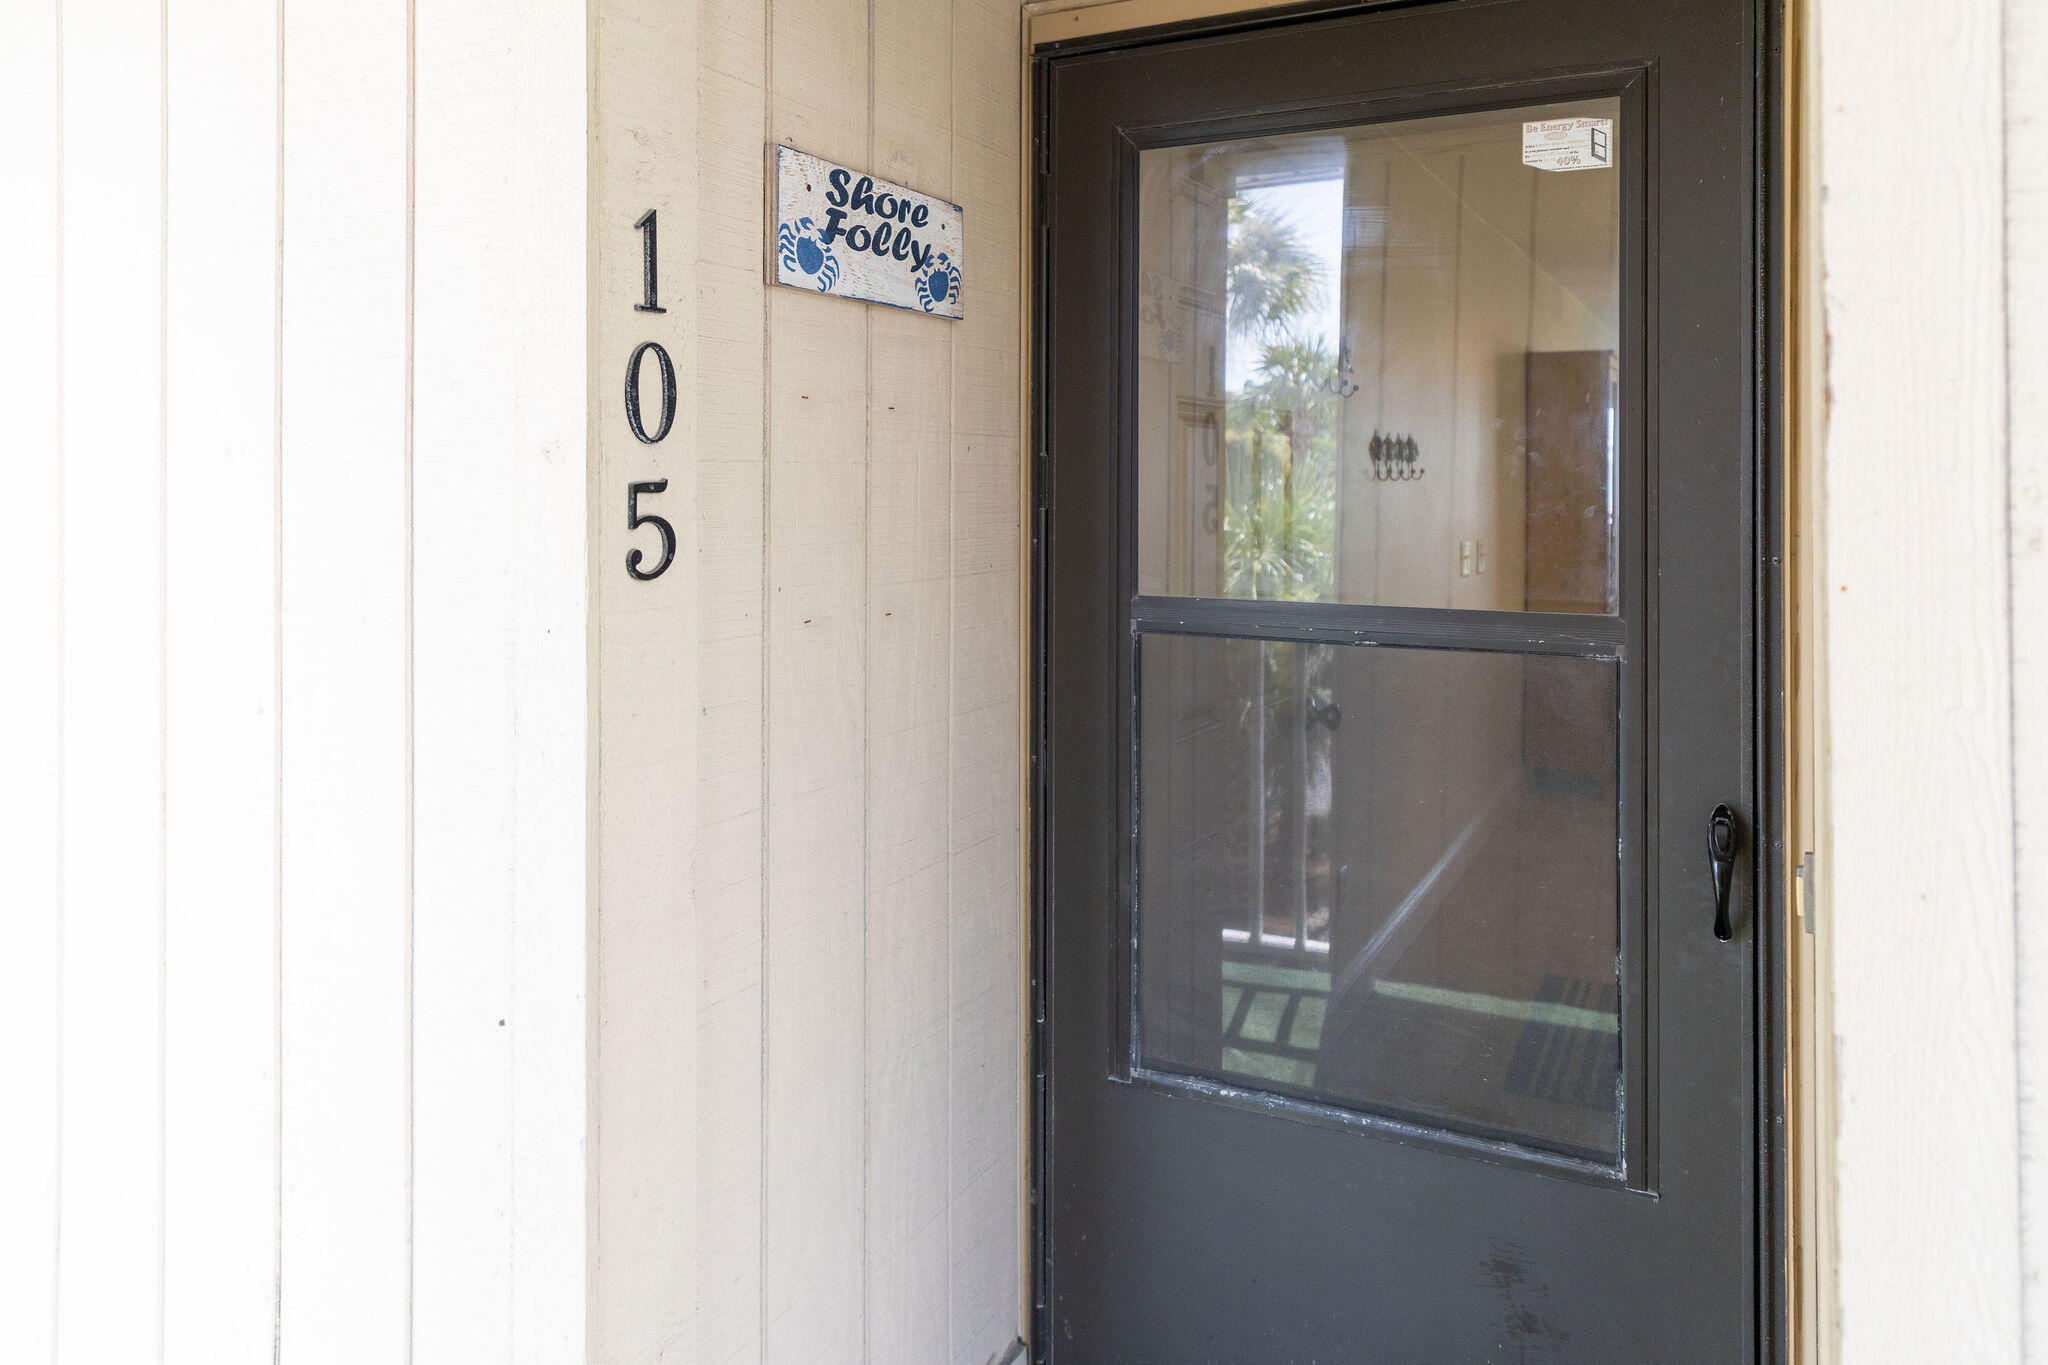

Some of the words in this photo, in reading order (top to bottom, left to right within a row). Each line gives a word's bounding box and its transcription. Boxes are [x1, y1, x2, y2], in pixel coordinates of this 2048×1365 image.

[1526, 124, 1538, 134] Be
[1540, 121, 1574, 133] Energy
[1556, 154, 1582, 166] 40%
[825, 168, 929, 228] Shore
[825, 207, 932, 273] Folly
[624, 208, 678, 581] 105
